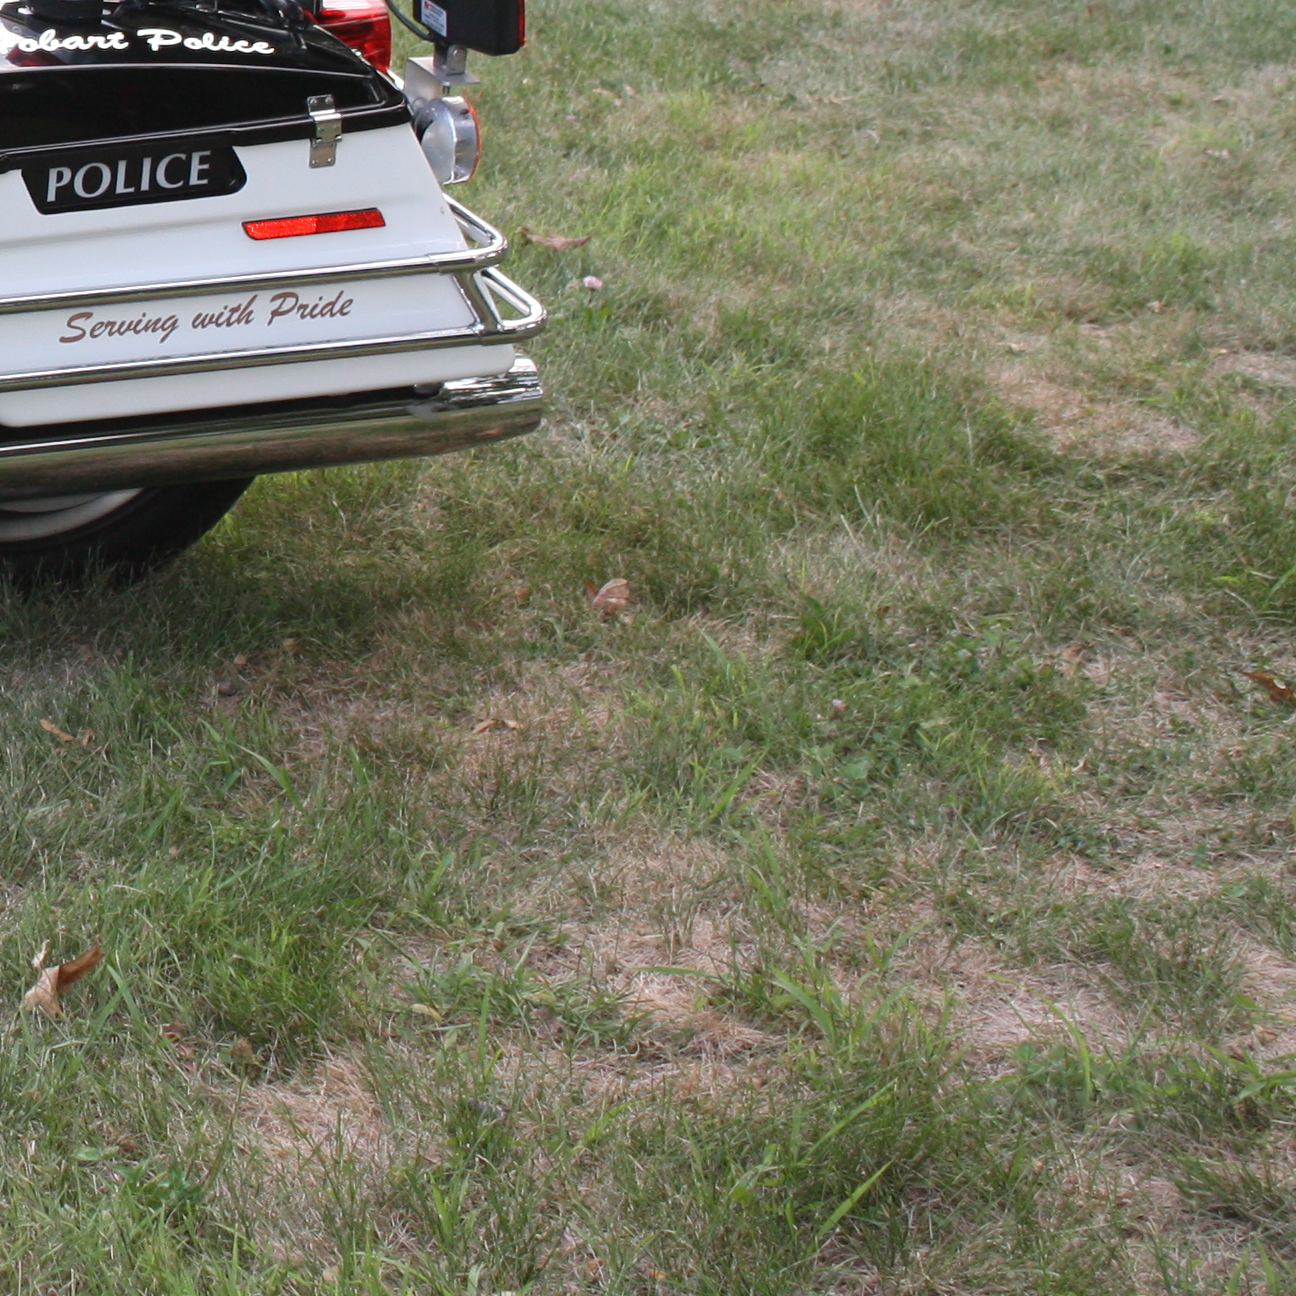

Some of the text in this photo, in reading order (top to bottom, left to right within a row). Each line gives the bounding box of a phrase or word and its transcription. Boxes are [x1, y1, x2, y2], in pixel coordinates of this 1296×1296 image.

[137, 27, 276, 55] Police
[46, 150, 212, 203] POLICE
[59, 289, 354, 344] Serving with Pride
